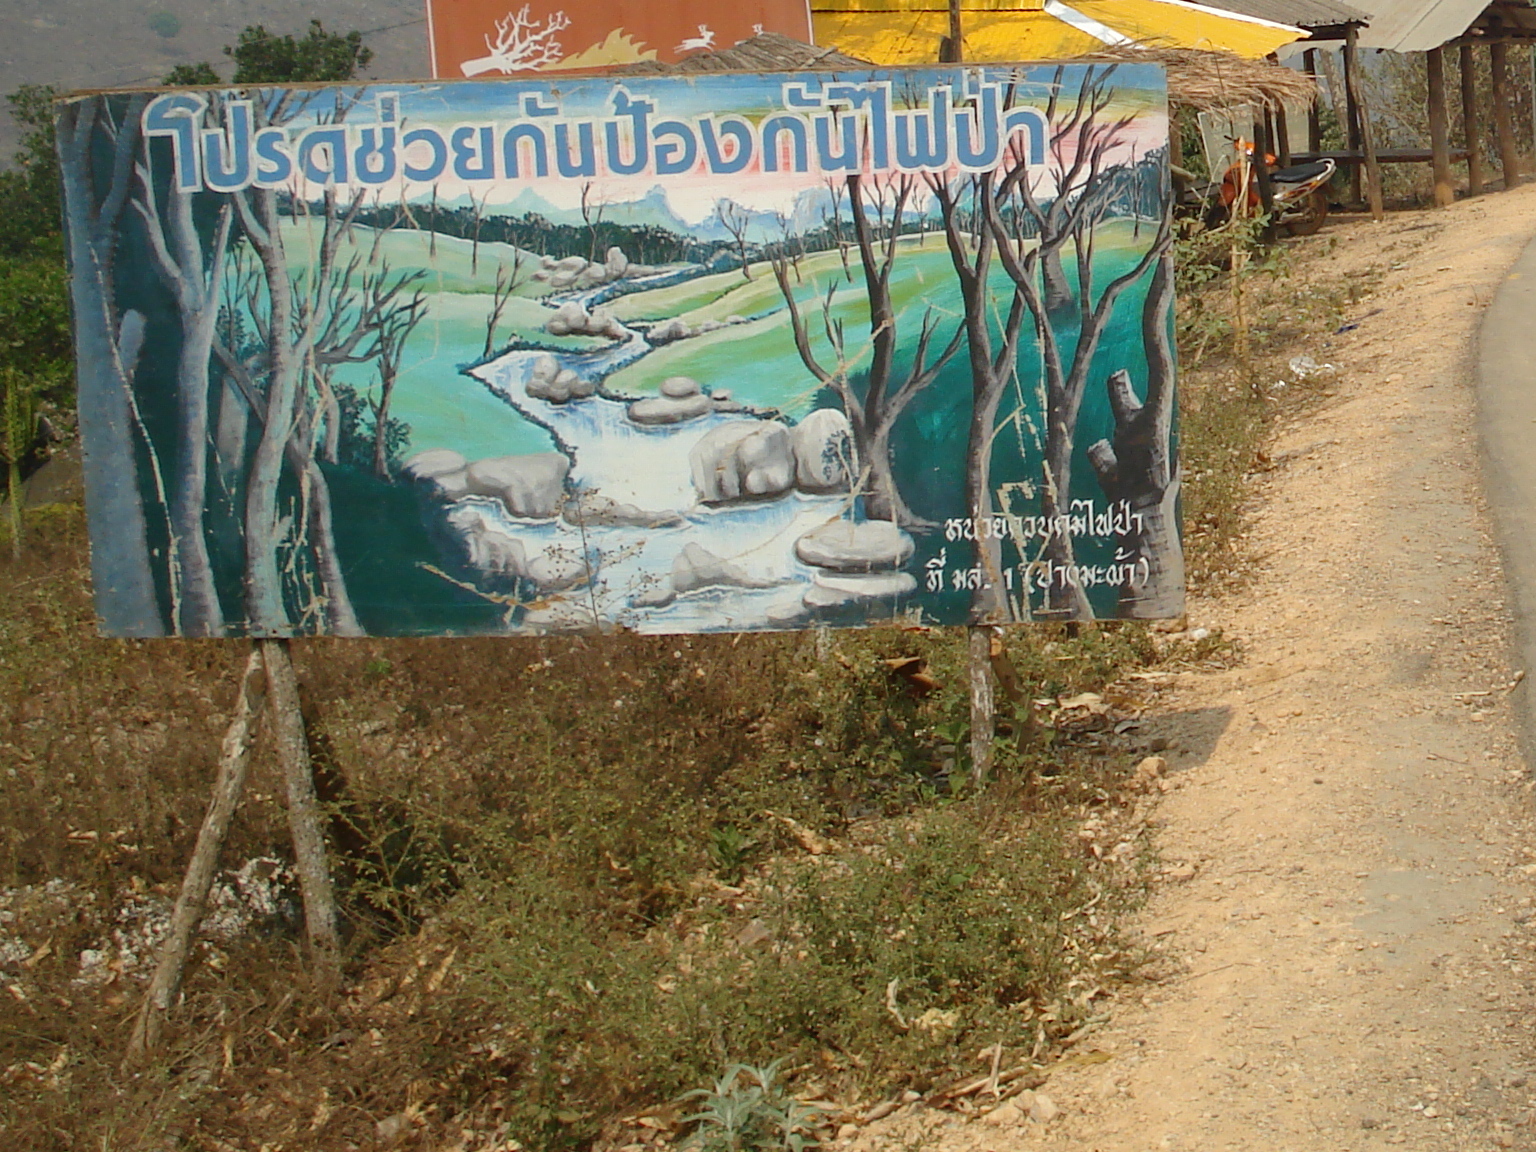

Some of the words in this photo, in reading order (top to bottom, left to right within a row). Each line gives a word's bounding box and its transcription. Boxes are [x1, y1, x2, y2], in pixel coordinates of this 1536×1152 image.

[142, 68, 1050, 192] โปรดช่วยกันป้องกันไฟป่า
[925, 547, 947, 593] ที่
